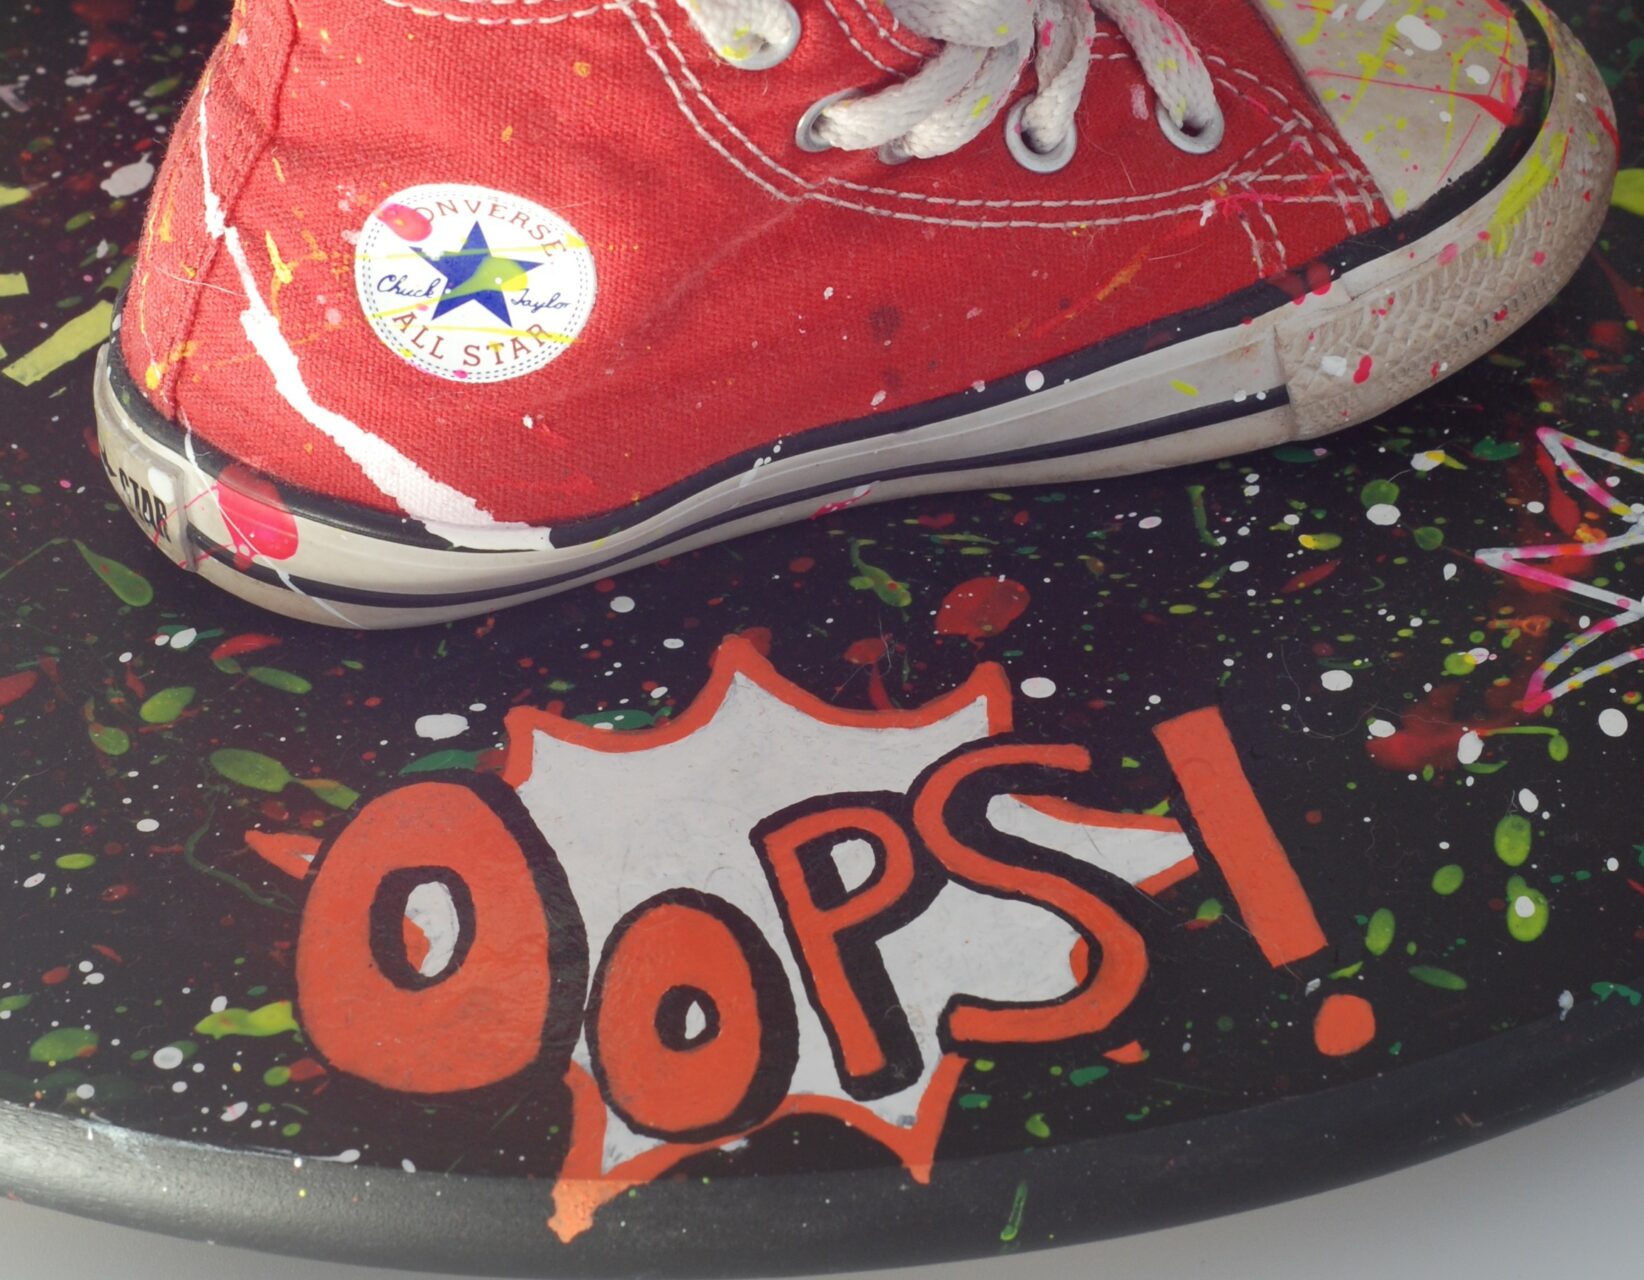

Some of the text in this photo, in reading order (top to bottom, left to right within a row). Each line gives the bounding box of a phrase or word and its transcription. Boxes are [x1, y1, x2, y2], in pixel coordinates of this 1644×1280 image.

[411, 198, 567, 257] ONVERSE
[376, 273, 571, 314] Chuck Taylor
[392, 311, 554, 368] ALL STAR
[295, 705, 1377, 1134] OOPS!
